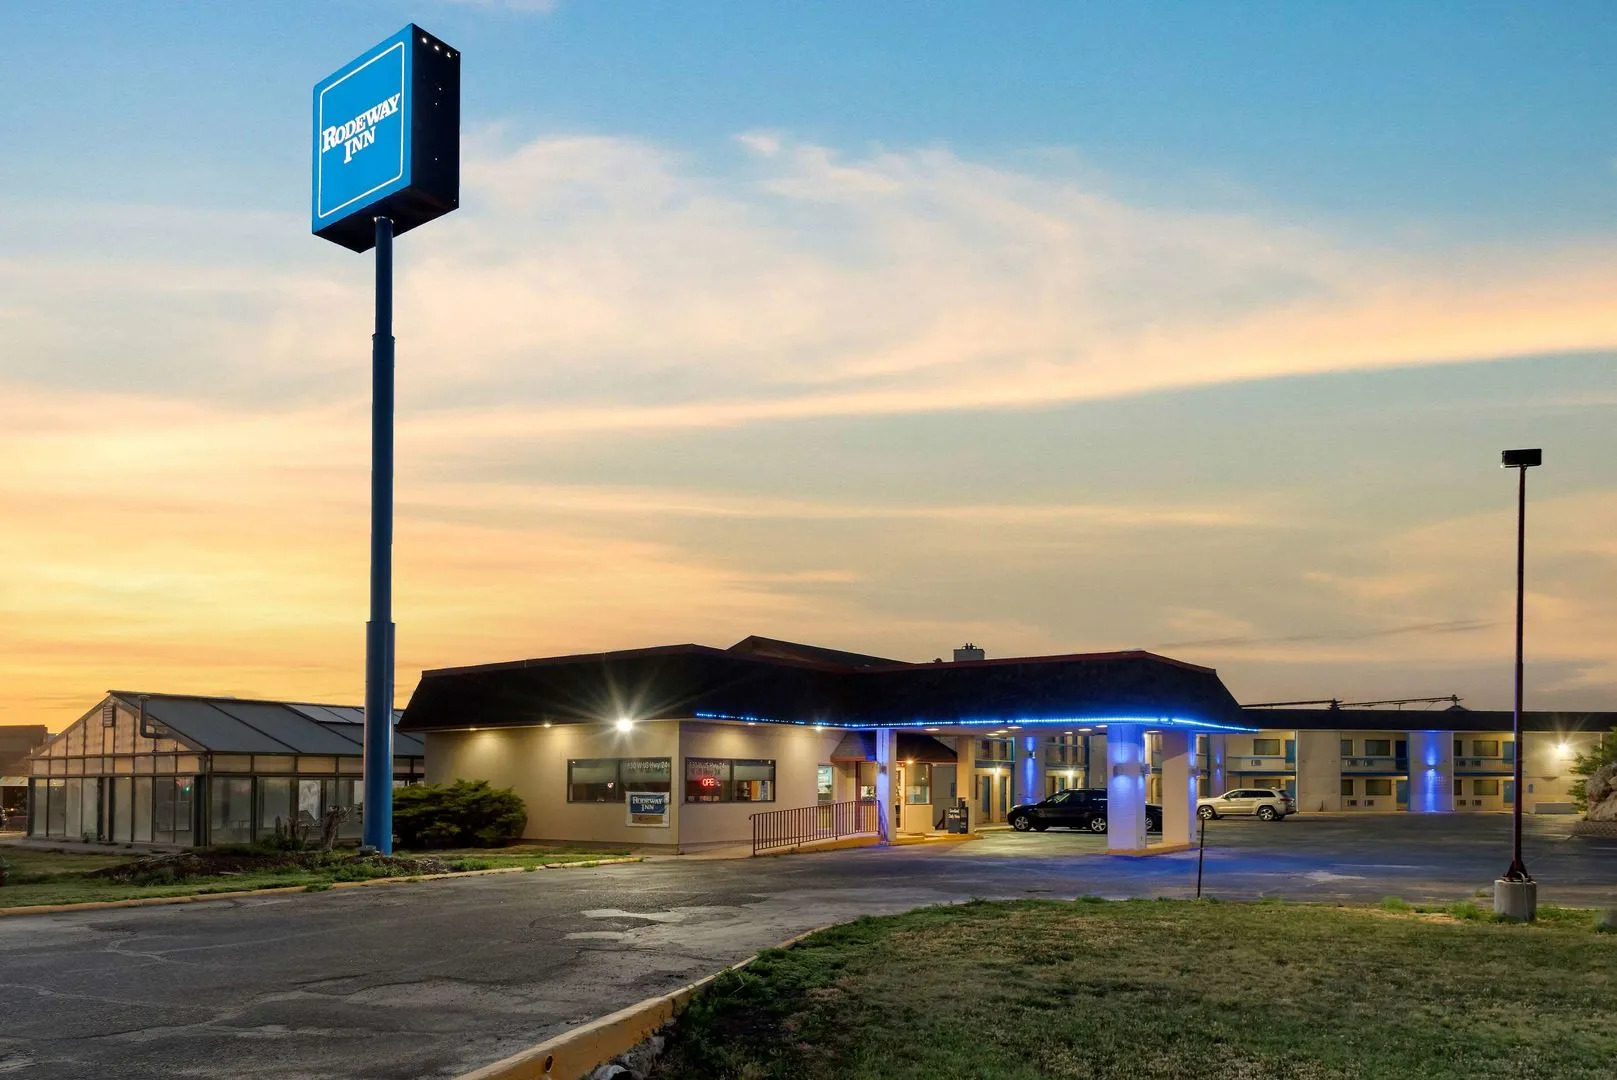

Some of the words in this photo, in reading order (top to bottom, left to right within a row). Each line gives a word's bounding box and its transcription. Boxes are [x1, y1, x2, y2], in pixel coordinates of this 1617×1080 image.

[322, 93, 400, 153] RODEWAY
[344, 126, 376, 164] INN
[641, 803, 655, 812] INN
